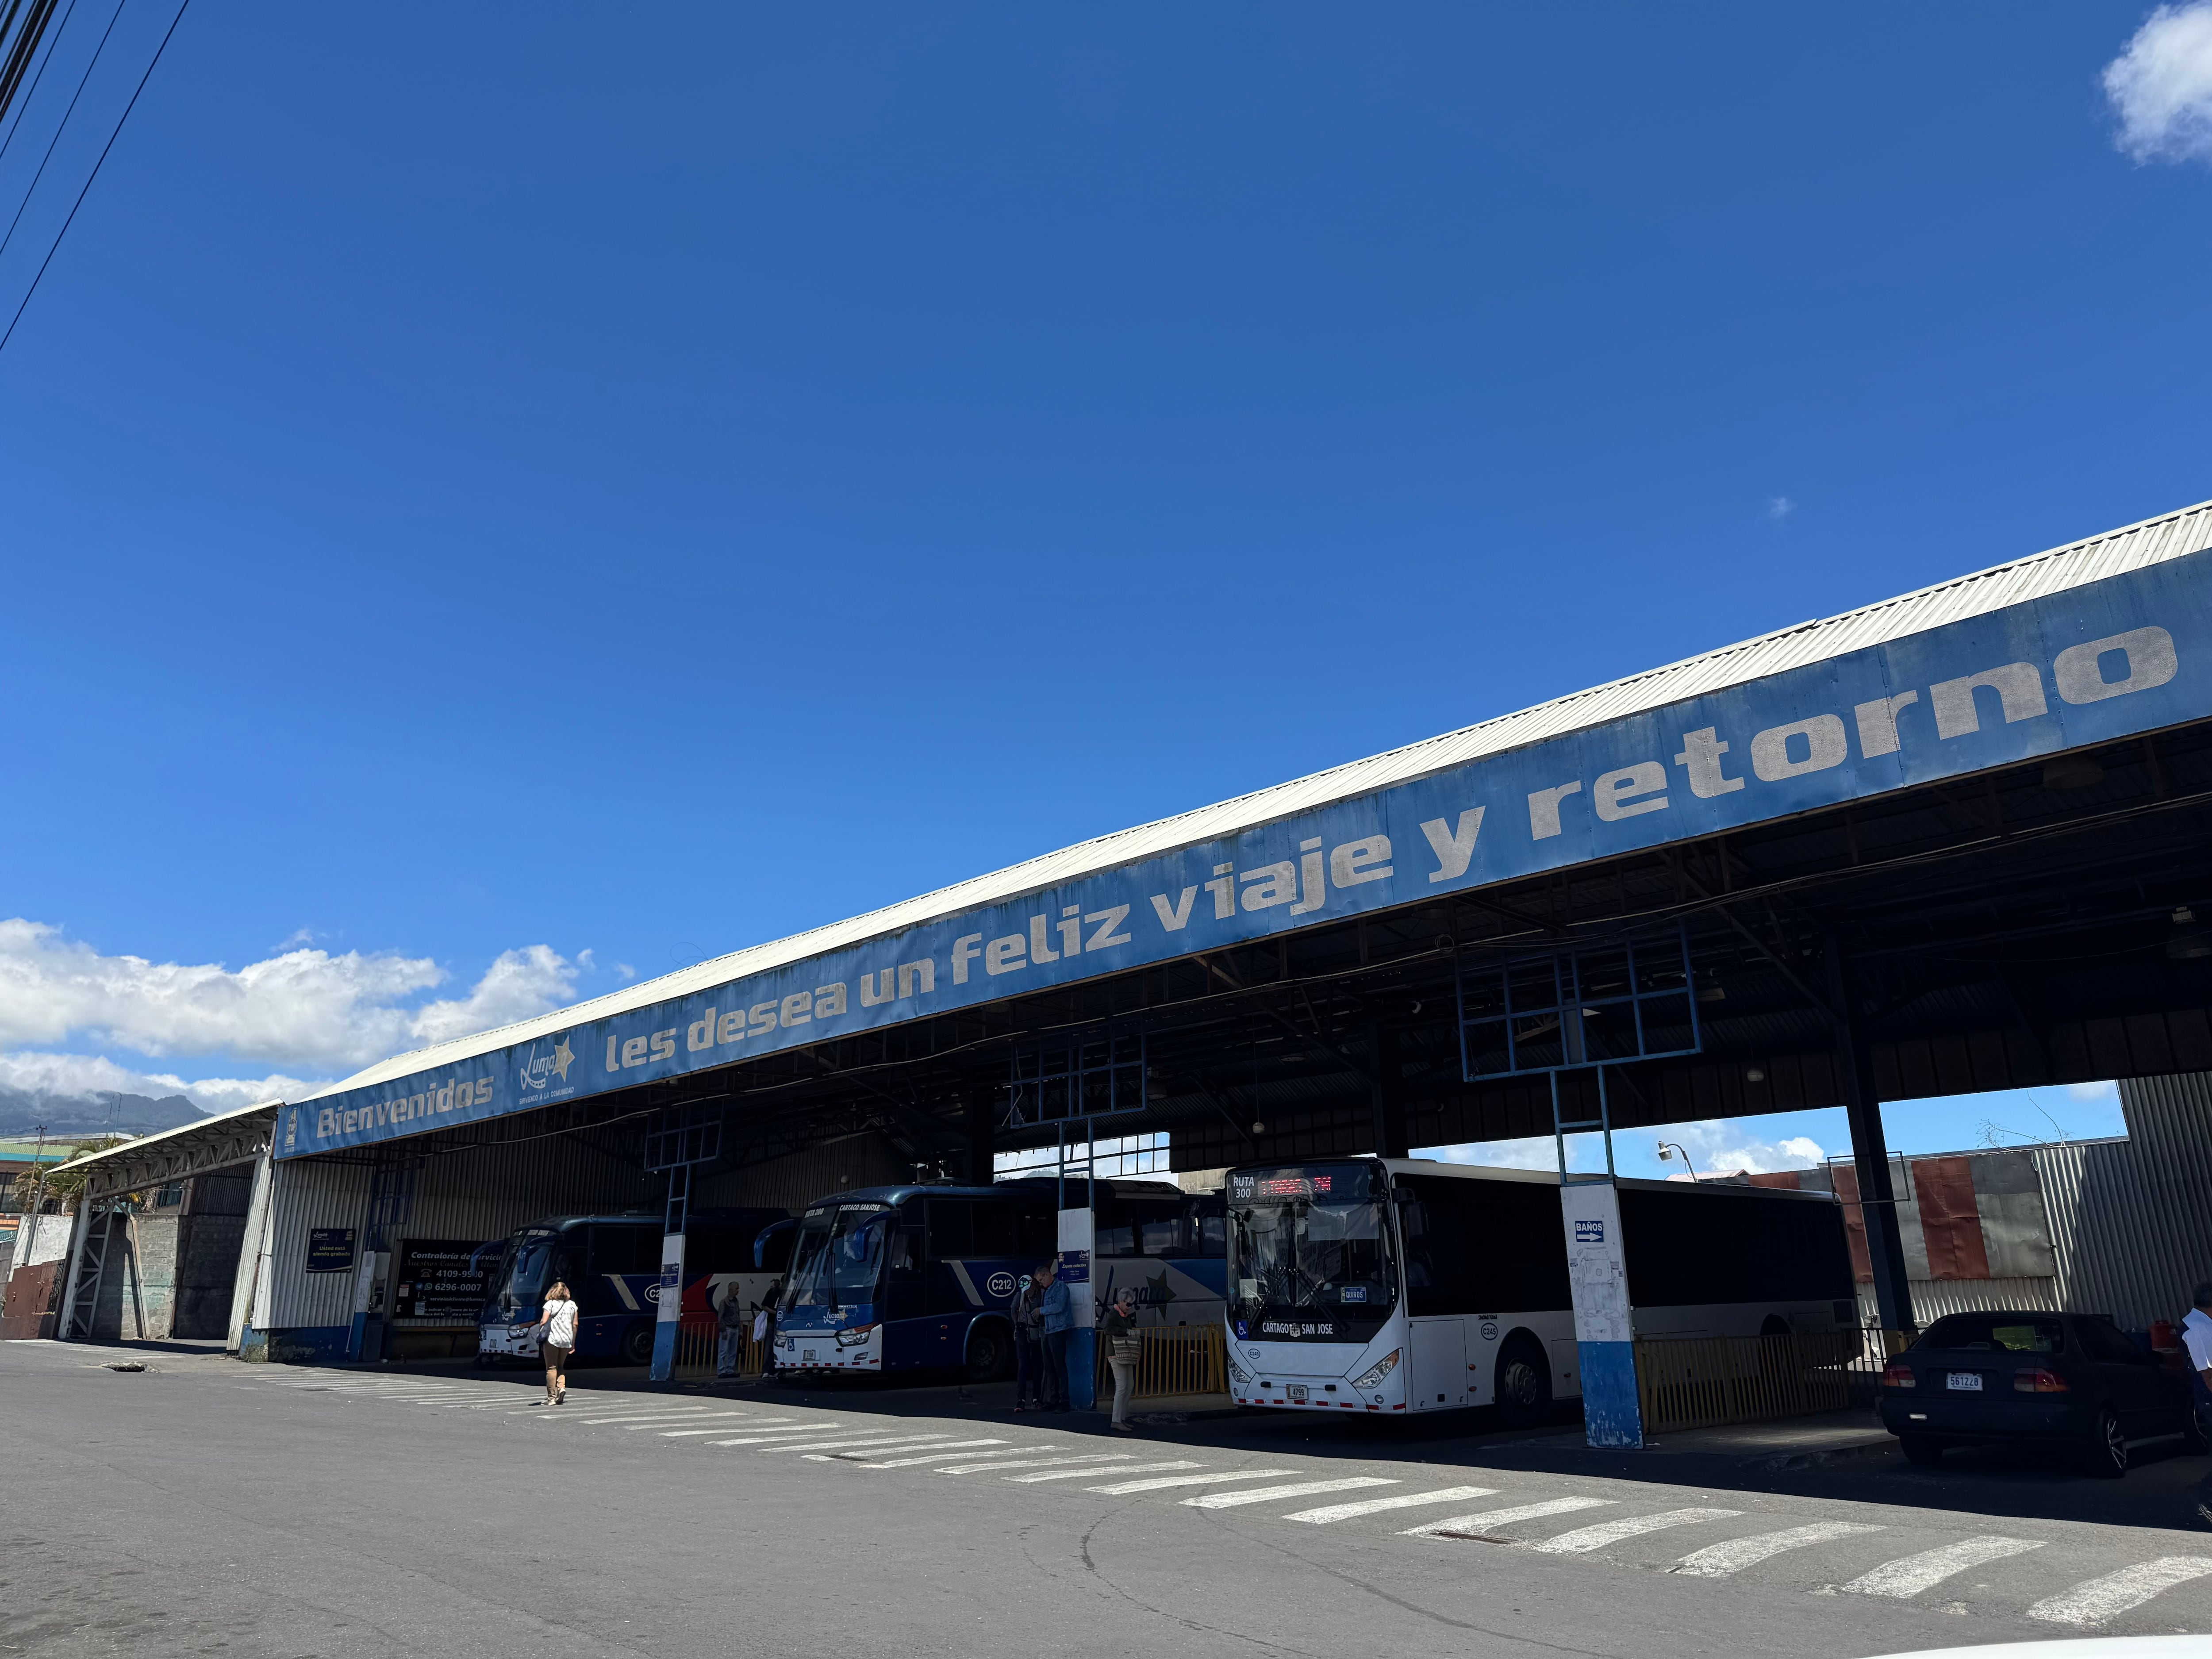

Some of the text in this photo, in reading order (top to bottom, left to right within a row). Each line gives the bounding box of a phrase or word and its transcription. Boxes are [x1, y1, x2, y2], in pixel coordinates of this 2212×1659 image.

[606, 626, 2178, 1072] les desea un feliz viaje y retorno
[317, 1076, 494, 1138] Bienvenidos
[1233, 1176, 1255, 1187] RUTA
[1235, 1188, 1251, 1198] 300
[1575, 1221, 1603, 1232] BAÑOS
[411, 1251, 458, 1260] Contraloría
[436, 1270, 483, 1278] 4109-990
[435, 1283, 482, 1291] 6296-0007
[991, 1279, 1012, 1290] C212
[1262, 1321, 1333, 1335] CARTAGO SAN JOSE
